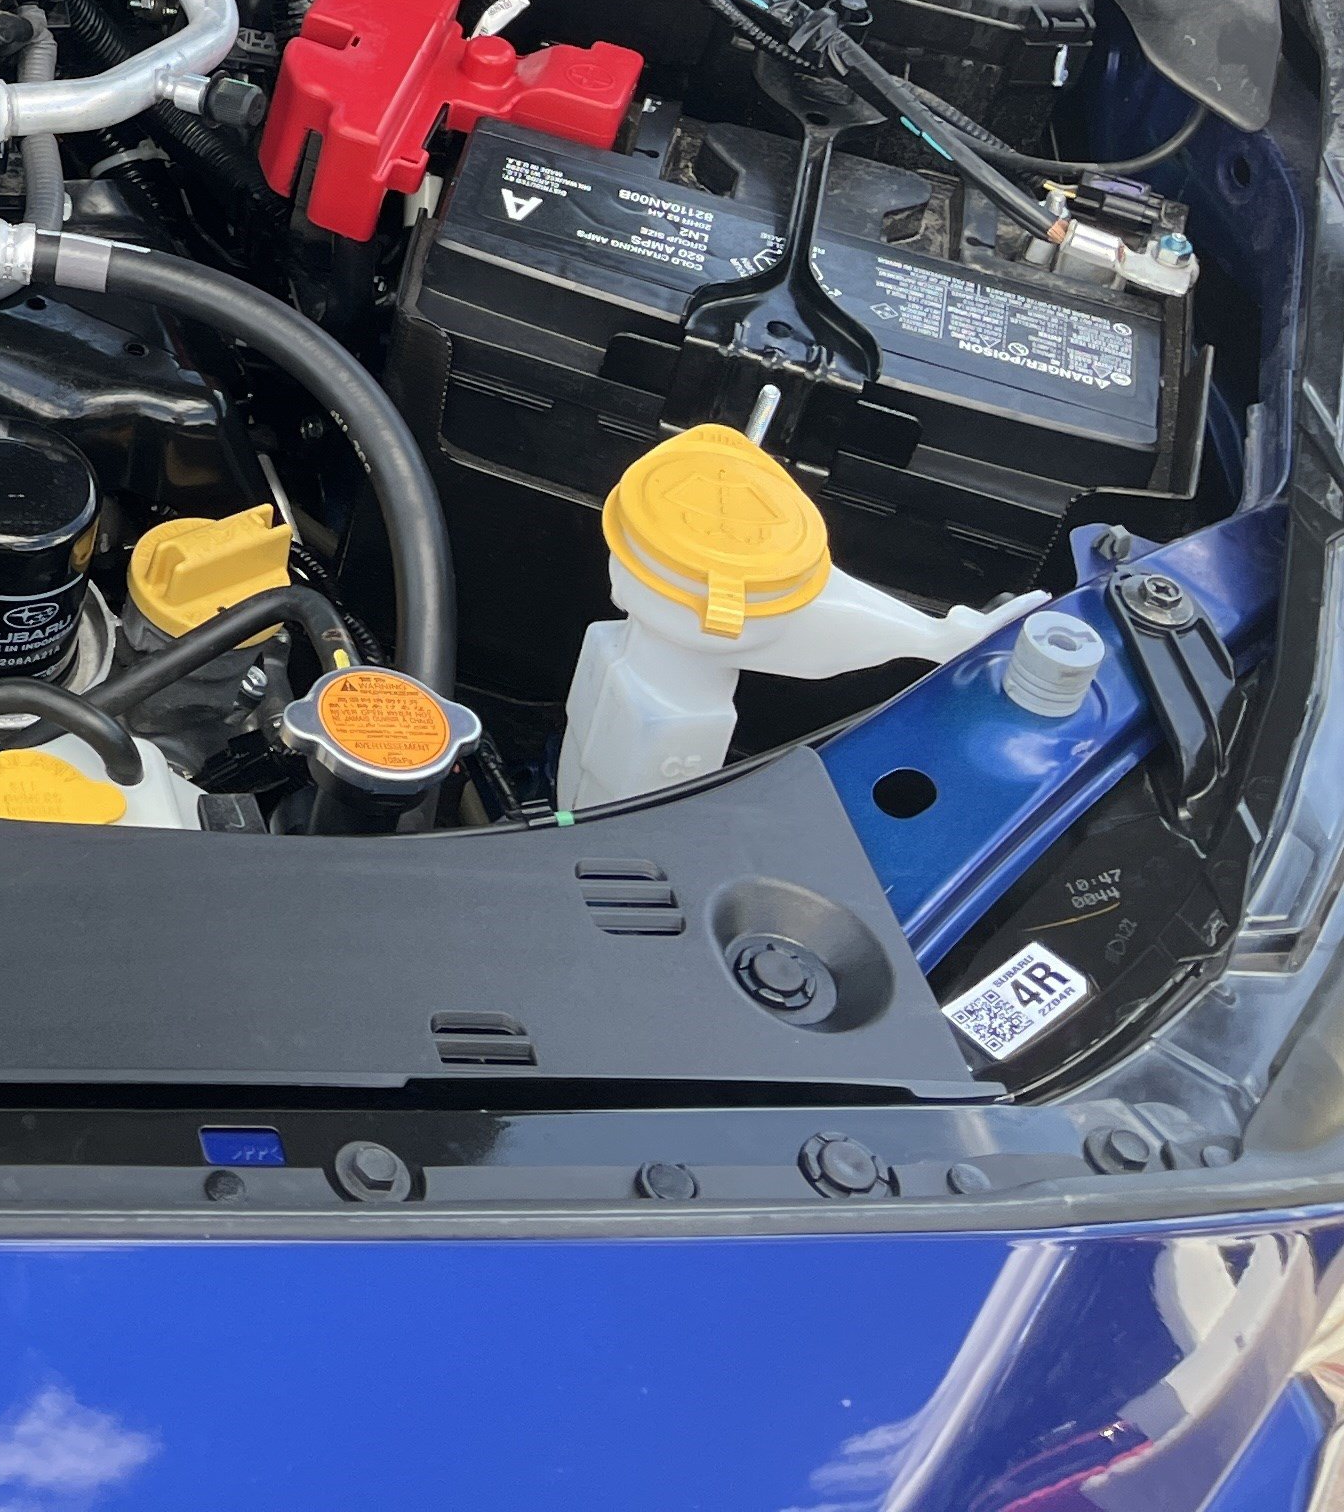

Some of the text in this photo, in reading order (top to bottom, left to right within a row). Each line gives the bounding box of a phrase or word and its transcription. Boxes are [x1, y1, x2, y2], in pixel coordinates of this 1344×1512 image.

[500, 188, 543, 222] A
[617, 188, 714, 223] 82110AN00B
[630, 234, 706, 263] 620 AMPS
[639, 226, 707, 253] GROUP SIZE
[678, 226, 710, 243] LN2
[576, 229, 703, 272] COLD CRANKING AMPS
[958, 339, 1094, 387] DANGER/POISON
[4, 644, 20, 653] IN
[1064, 868, 1122, 895] 10:47
[1070, 886, 1122, 909] 0044
[992, 954, 1035, 990] SUBARU
[1010, 961, 1072, 1009] 4R
